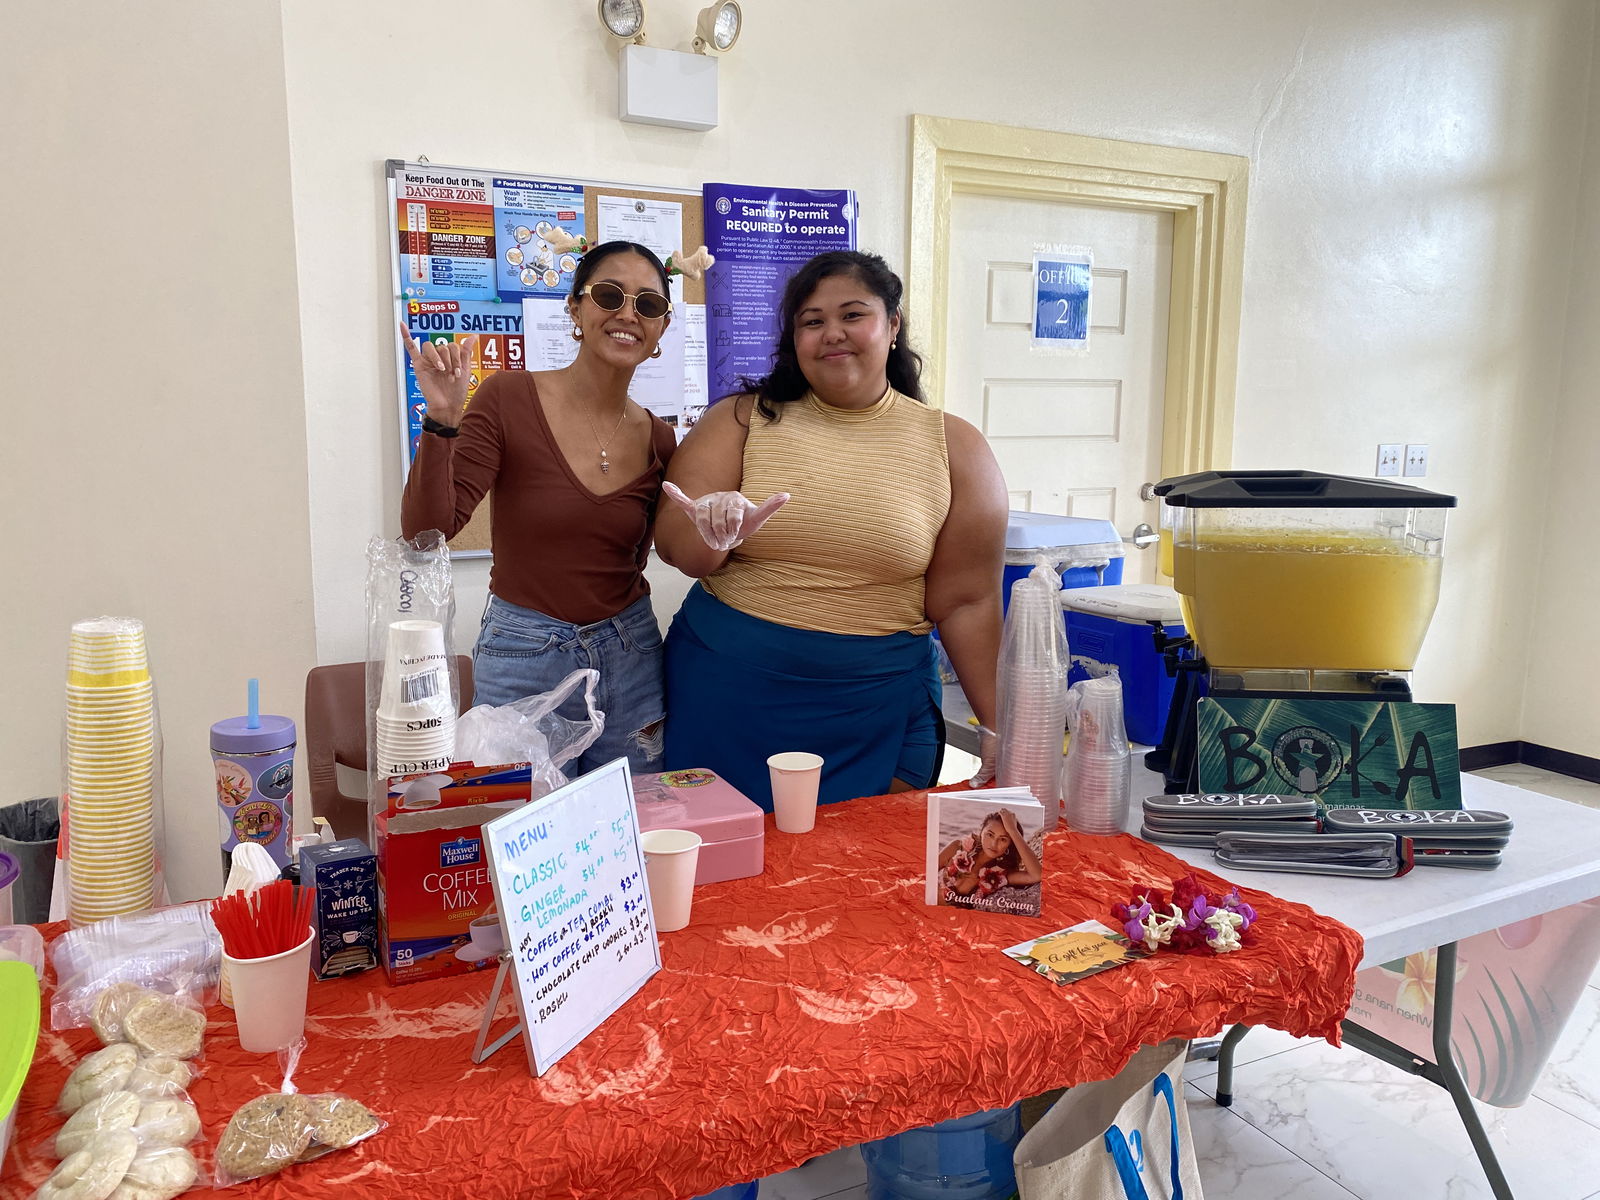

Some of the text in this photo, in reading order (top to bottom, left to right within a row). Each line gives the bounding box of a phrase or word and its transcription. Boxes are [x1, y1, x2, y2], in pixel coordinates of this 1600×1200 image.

[406, 174, 423, 184] Keep
[427, 176, 444, 185] Food
[447, 177, 459, 186] Out
[472, 179, 485, 188] The
[516, 182, 533, 190] Safety
[405, 186, 486, 201] DANGER ZONE
[733, 198, 768, 206] Environmental
[742, 206, 829, 221] Sanitary Permit
[726, 220, 846, 236] REQUIRED to operate
[432, 233, 486, 244] DANGER ZONE
[1039, 267, 1088, 286] OFFIC
[410, 299, 457, 313] 5 Steps to
[1056, 298, 1069, 324] 2
[409, 313, 523, 332] FOOD SAFETY
[484, 338, 498, 360] 4
[509, 339, 522, 360] 5
[406, 717, 443, 732] 50PCS
[389, 761, 418, 774] CUP
[515, 763, 526, 771] 50
[1177, 793, 1282, 806] BOKA
[1357, 810, 1475, 824] BOKA
[504, 820, 553, 861] MENU:
[442, 844, 479, 857] Maxwell
[446, 853, 475, 865] House
[330, 867, 349, 879] TRADER
[513, 852, 567, 894] CLASSIC
[331, 895, 369, 911] WINTER
[443, 889, 479, 911] MIX
[520, 884, 566, 922] GINGER
[945, 891, 1034, 911] Pualani Crown
[327, 911, 347, 919] WAKE
[447, 910, 477, 921] ORIGINAL
[536, 889, 588, 928] LEMONADA
[519, 933, 533, 953] HOT
[527, 931, 559, 962] COFFEE
[567, 913, 585, 933] TEA
[397, 948, 413, 960] 50
[531, 963, 549, 983] HOT
[552, 938, 582, 968] COFFEE
[595, 918, 611, 936] TEA
[1063, 948, 1077, 963] gift
[1077, 945, 1091, 957] for
[1092, 940, 1108, 953] you
[536, 960, 580, 1001] CHOCOLATE
[582, 944, 600, 969] CHIP
[602, 925, 627, 950] COOKIES
[539, 992, 568, 1023] ROSKU
